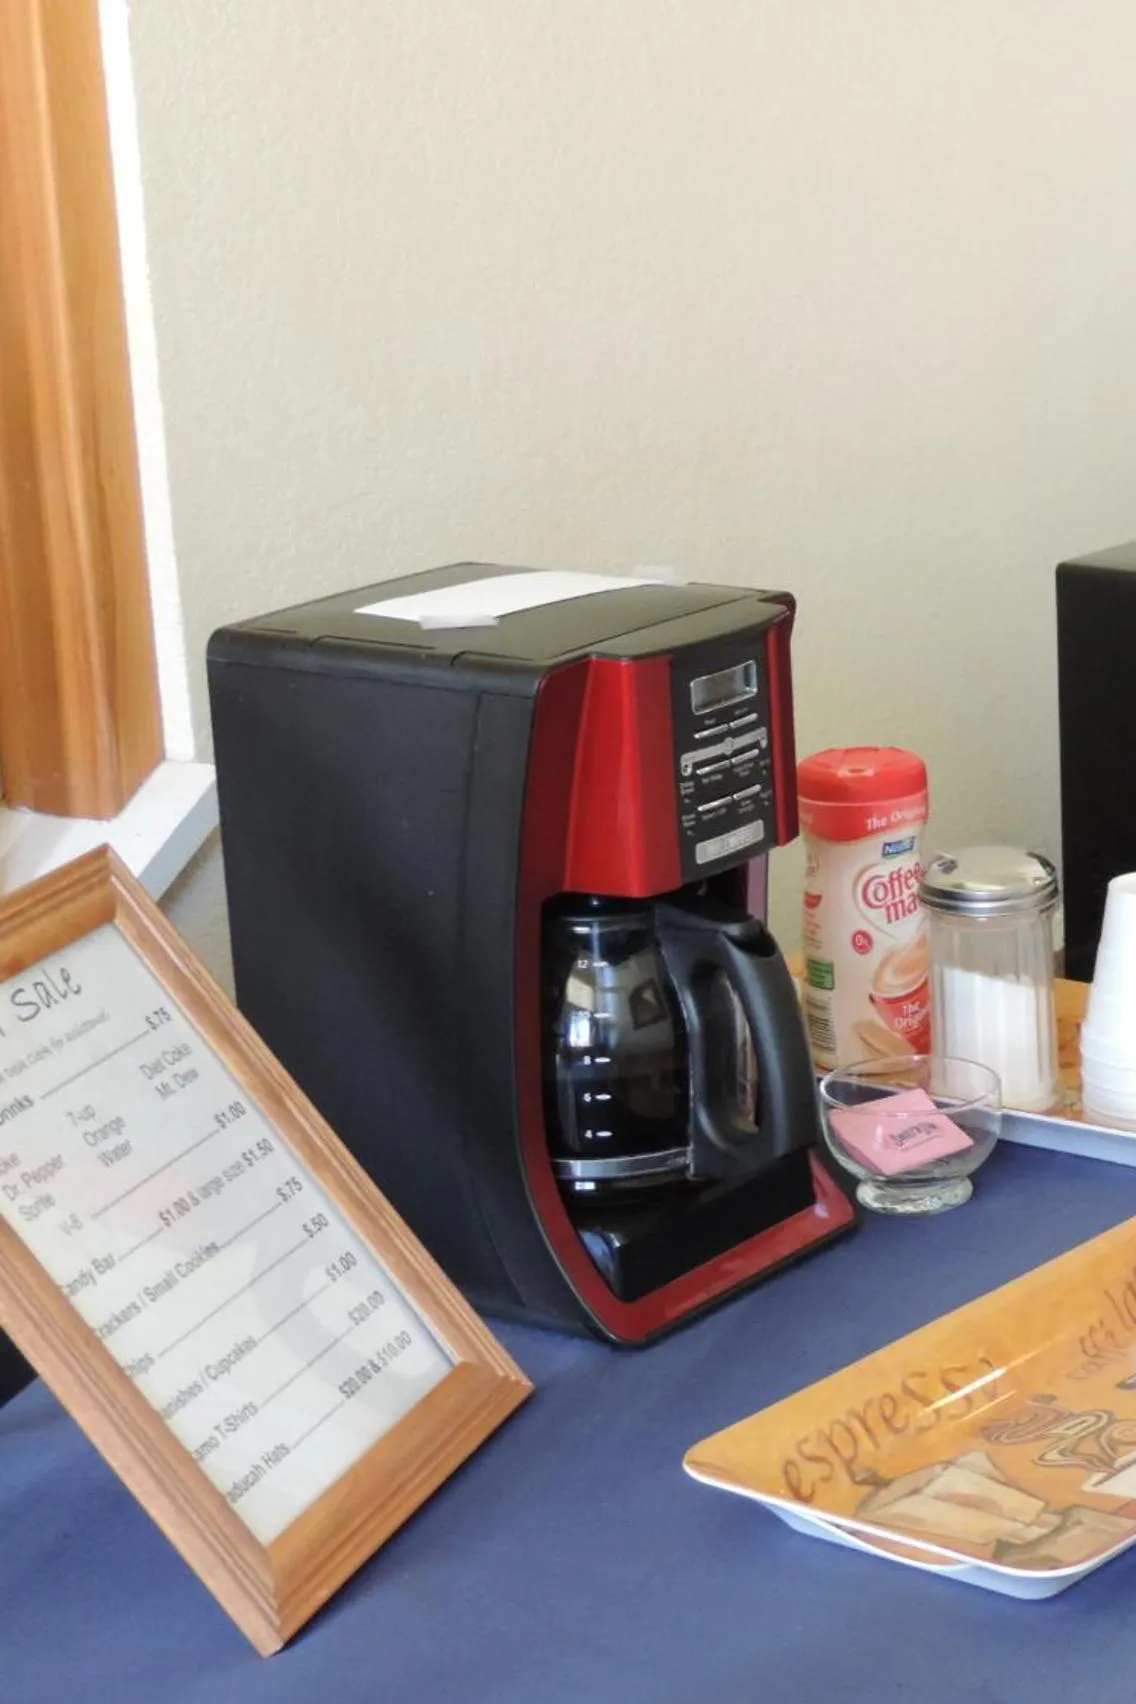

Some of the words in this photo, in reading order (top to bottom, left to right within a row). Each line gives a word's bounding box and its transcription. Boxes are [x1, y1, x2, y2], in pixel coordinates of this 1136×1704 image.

[862, 862, 927, 909] Coffee
[885, 892, 920, 925] ma
[11, 966, 82, 1023] Sale
[145, 1007, 172, 1031] $.75
[162, 1043, 193, 1066] Coke
[82, 1115, 126, 1147] Orange
[214, 1101, 247, 1130] $1.00
[20, 1154, 65, 1188] Pepper
[98, 1139, 133, 1167] Water
[65, 1268, 97, 1296] andy
[91, 1253, 117, 1275] Bar
[158, 1196, 191, 1228] $1.00
[241, 1138, 274, 1168] $1.50
[302, 1212, 329, 1239] $.50
[97, 1300, 142, 1339] rackers
[142, 1269, 179, 1303] Small
[174, 1241, 220, 1278] Cookies
[276, 1176, 303, 1202] $.75
[204, 1335, 258, 1380] Cupcakes
[325, 1251, 358, 1283] $1.00
[193, 1435, 220, 1462] amo
[213, 1400, 259, 1439] T-Shirts
[348, 1289, 385, 1326] $20.00
[226, 1463, 267, 1503] aducah
[260, 1442, 291, 1469] Hats
[376, 1330, 412, 1367] $10.00
[783, 1356, 996, 1503] espress
